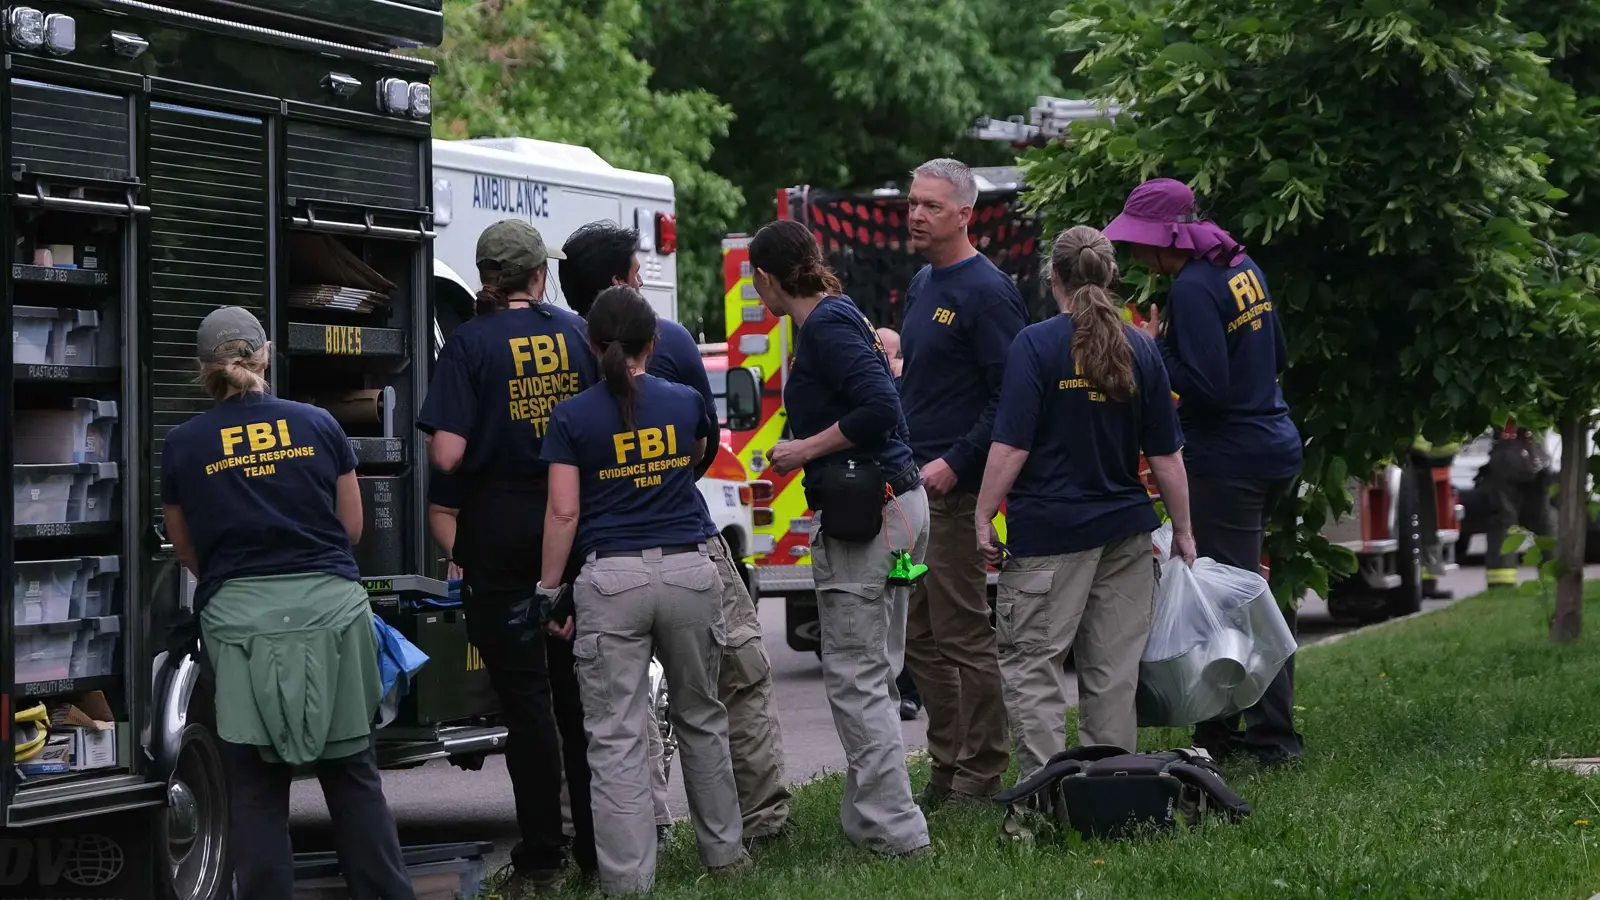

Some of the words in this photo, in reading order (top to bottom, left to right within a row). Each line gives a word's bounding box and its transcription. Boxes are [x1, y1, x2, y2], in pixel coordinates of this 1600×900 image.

[472, 175, 549, 218] AMBULANCE
[44, 268, 54, 281] ZIP
[56, 269, 68, 282] TIES
[94, 272, 108, 285] TAPE
[1228, 269, 1266, 312] FBI
[932, 307, 956, 326] FBI
[325, 325, 362, 355] BOXES
[508, 332, 570, 377] FBI
[29, 365, 53, 378] PLASTIC
[53, 366, 69, 379] BAGS
[508, 372, 579, 400] EVIDENCE
[1058, 379, 1094, 390] EVIDEN
[509, 393, 575, 421] RESPO
[220, 418, 292, 456] FBI
[612, 424, 677, 464] FBI
[386, 440, 402, 451] BROWN
[205, 454, 257, 475] EVIDENCE
[259, 446, 315, 462] RESPONSE
[386, 452, 402, 462] PAPER
[243, 464, 276, 478] TEAM
[599, 463, 646, 481] EVIDENCE
[374, 481, 390, 492] TRACE
[633, 475, 662, 488] TEAM
[374, 492, 392, 502] VACUUM
[375, 507, 390, 517] TRACE
[36, 524, 55, 536] PAPER
[55, 523, 71, 535] BAGS
[375, 518, 393, 529] FILTERS
[58, 679, 74, 692] BAGS
